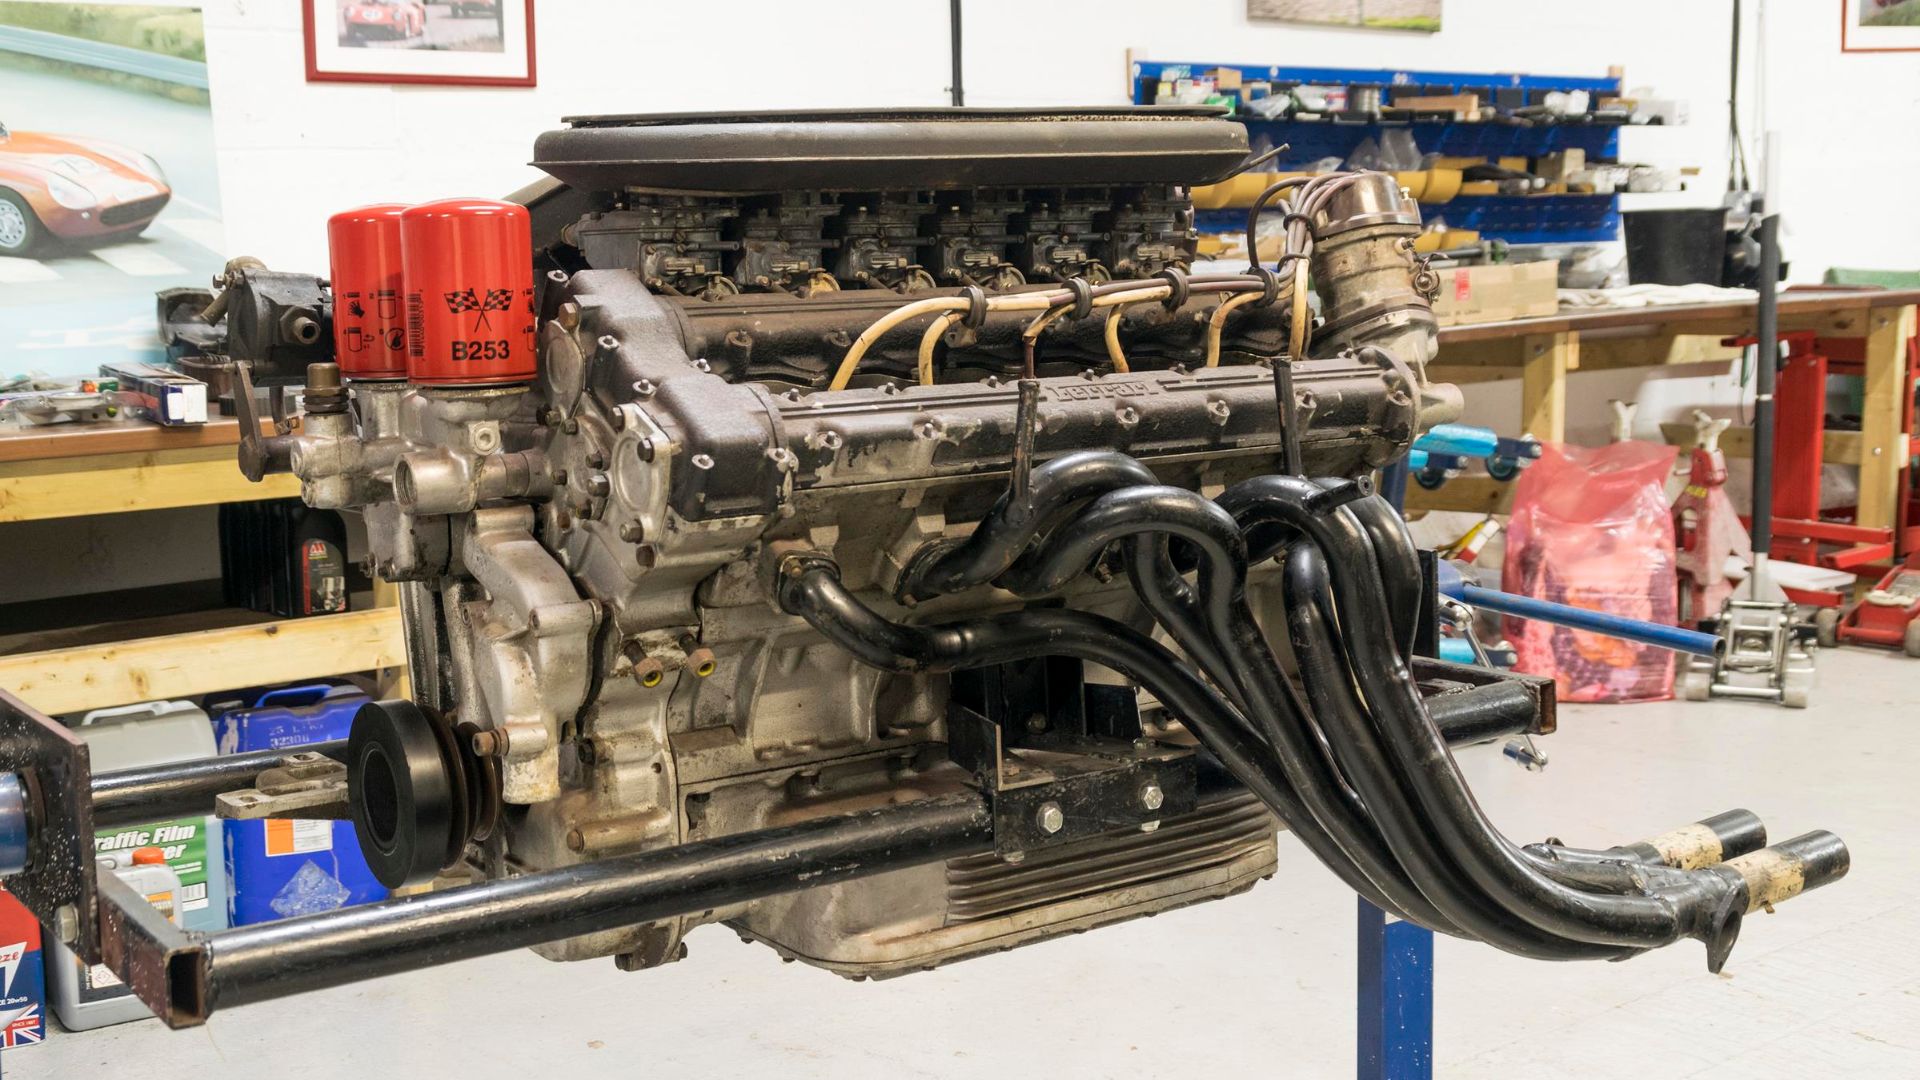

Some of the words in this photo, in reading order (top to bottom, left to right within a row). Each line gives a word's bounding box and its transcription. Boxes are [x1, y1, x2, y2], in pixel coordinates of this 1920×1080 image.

[451, 339, 511, 361] B253
[1046, 380, 1159, 402] Ferrari
[94, 831, 150, 852] raffic
[152, 825, 196, 844] Film
